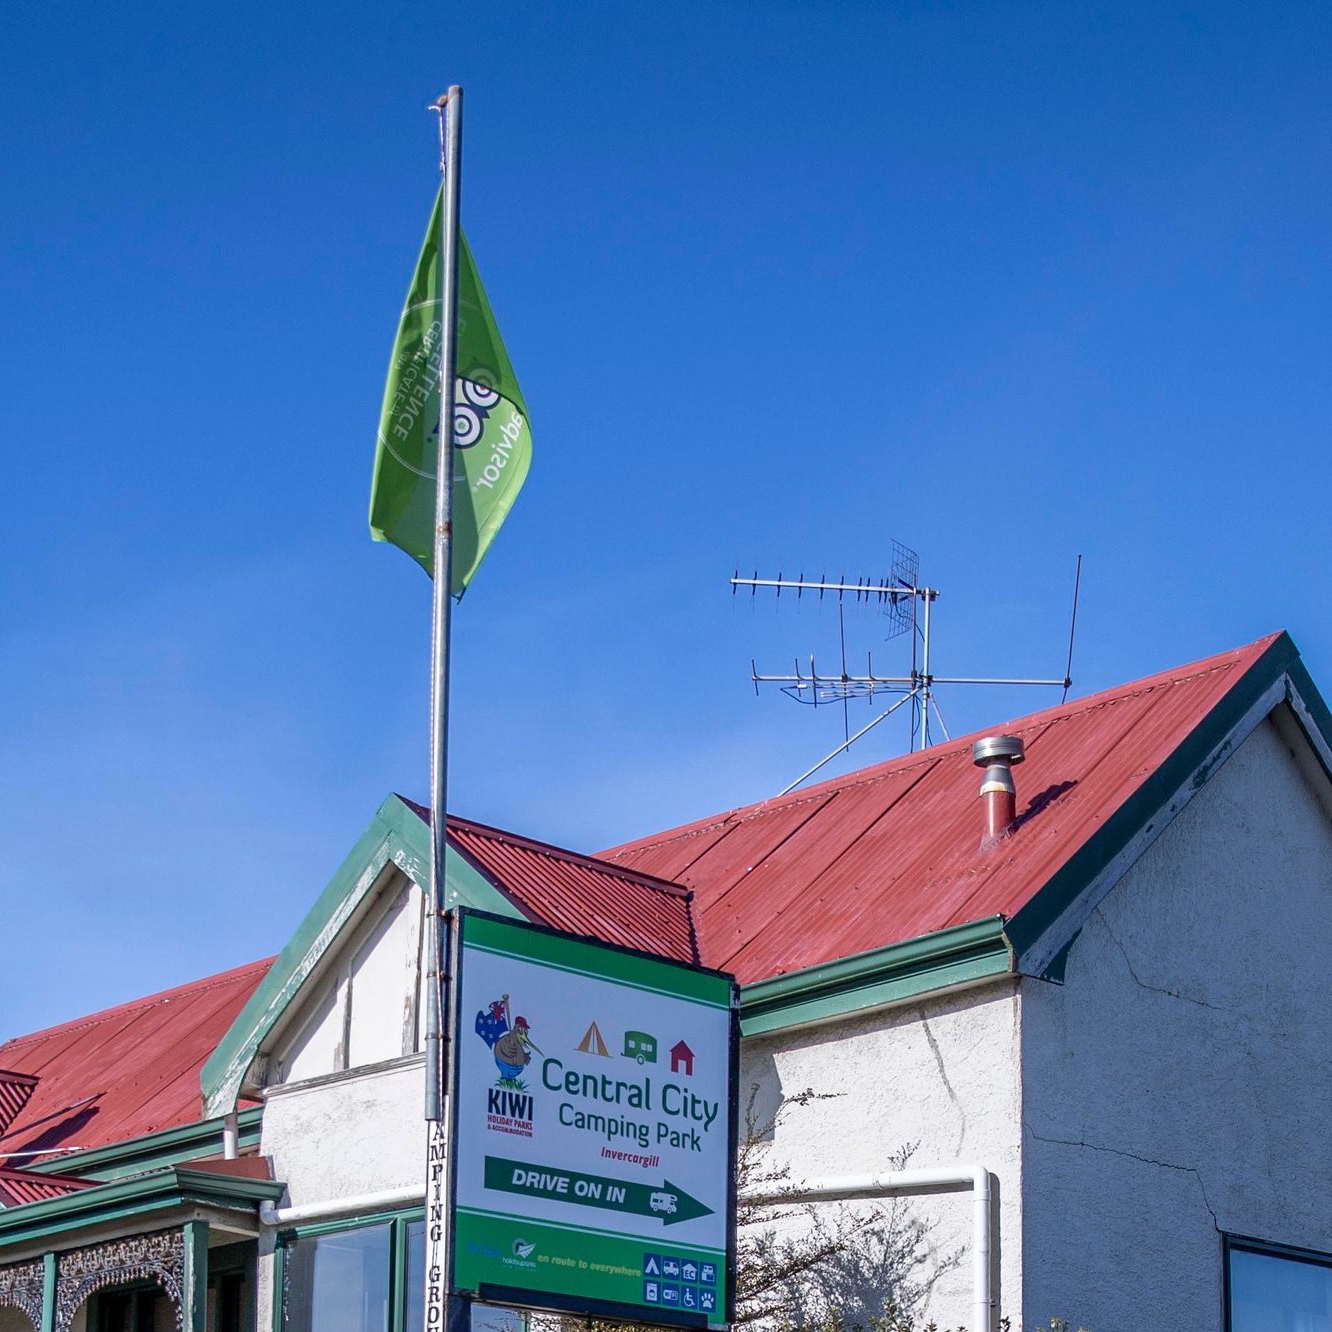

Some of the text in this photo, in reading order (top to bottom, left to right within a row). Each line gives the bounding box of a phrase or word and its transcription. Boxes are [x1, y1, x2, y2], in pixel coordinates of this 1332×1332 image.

[488, 1088, 533, 1121] KIWI
[542, 1058, 719, 1132] Central City
[487, 1114, 533, 1130] HOLIDAY PARKS
[559, 1102, 701, 1152] Camping Park
[601, 1147, 660, 1168] Invercargill
[429, 1121, 447, 1242] AMPING
[512, 1168, 626, 1203] DRIVE ON IN
[537, 1254, 642, 1277] en route to everywhere
